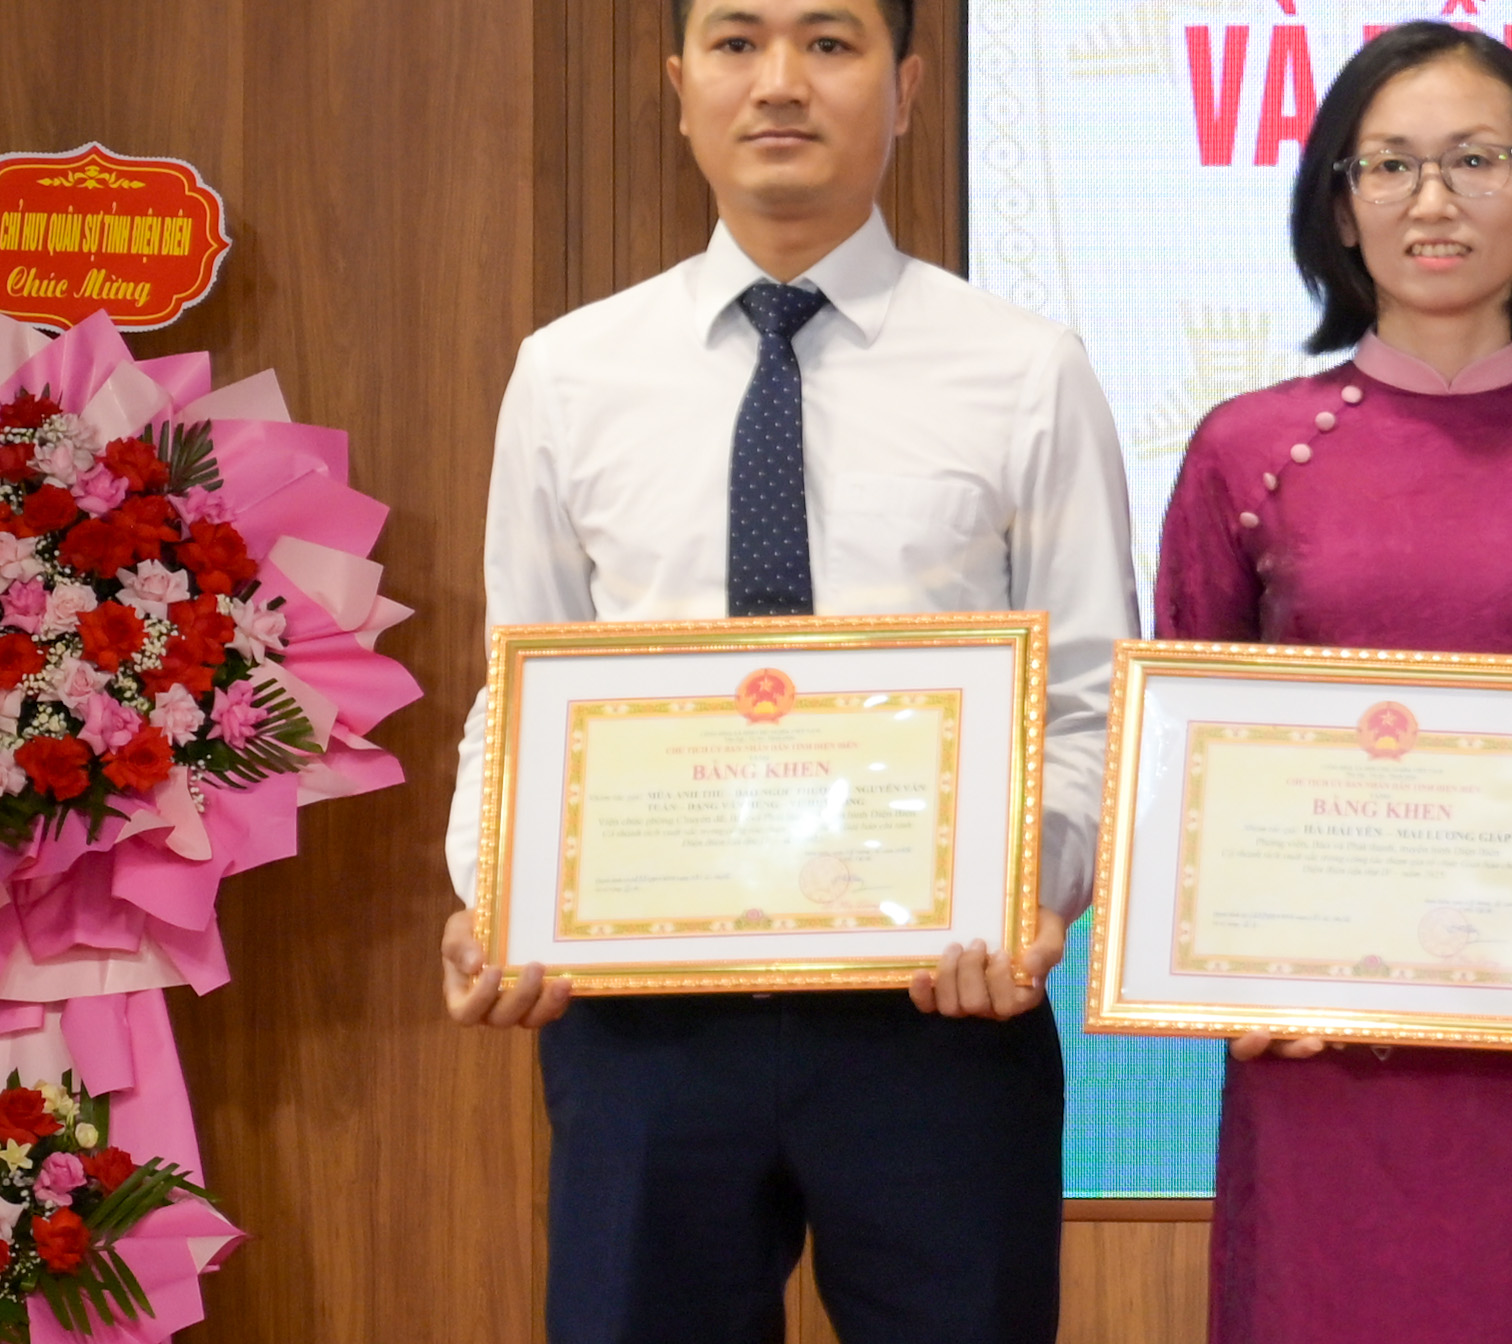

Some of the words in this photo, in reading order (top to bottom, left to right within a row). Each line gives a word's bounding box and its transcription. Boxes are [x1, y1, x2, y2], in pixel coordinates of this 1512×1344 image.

[21, 212, 48, 251] HUY
[47, 205, 82, 256] QUÂN
[82, 210, 104, 262] SỰ
[102, 201, 131, 254] TỈNH
[131, 207, 162, 263] ĐIỆN
[162, 208, 192, 256] BIÊN
[7, 266, 69, 298] Chúc
[74, 268, 151, 308] Mừng
[766, 760, 830, 778] KHEN
[1312, 794, 1377, 818] BẰNG
[1386, 801, 1453, 821] KHEN
